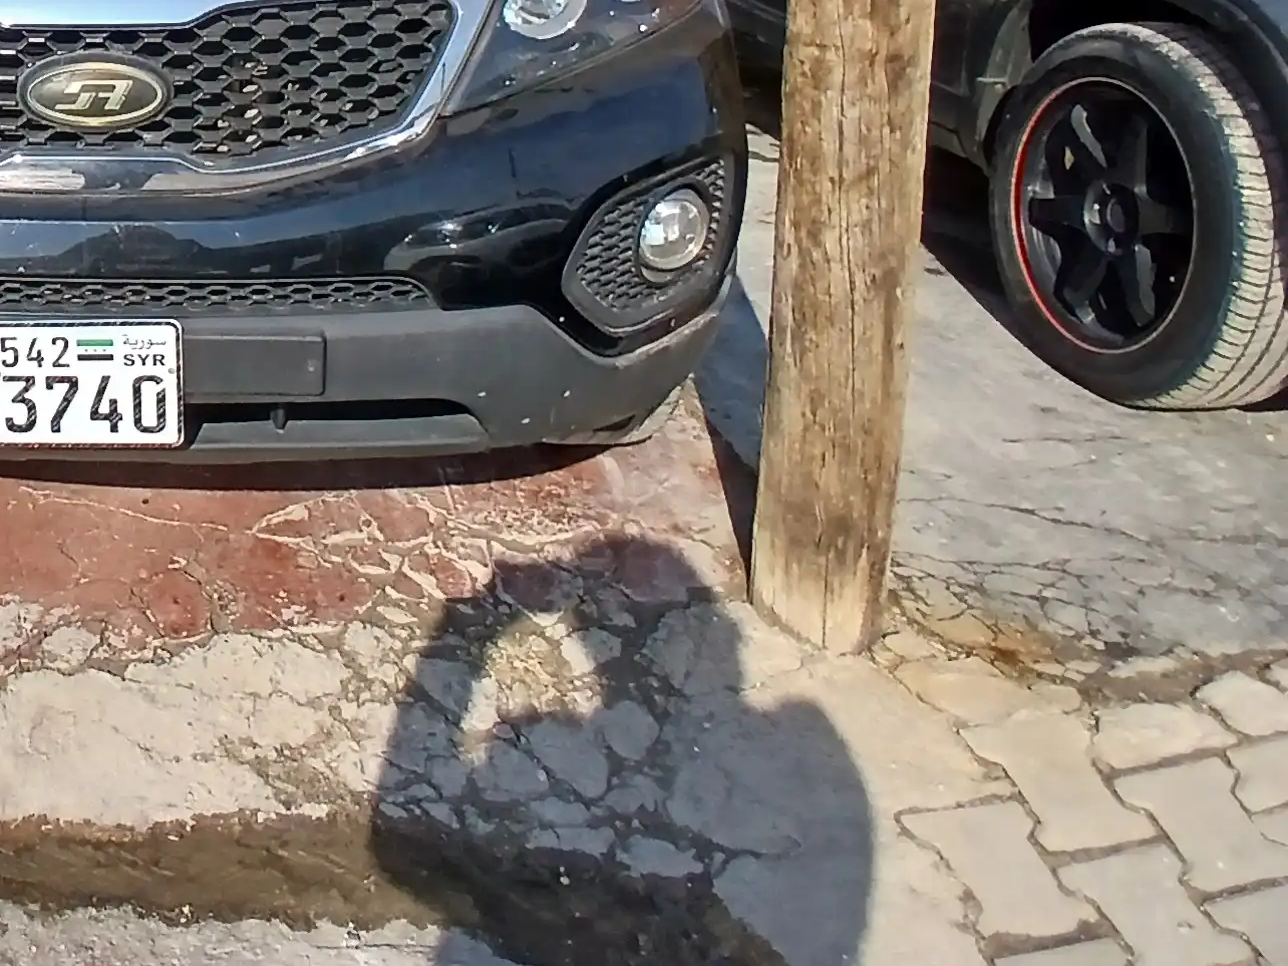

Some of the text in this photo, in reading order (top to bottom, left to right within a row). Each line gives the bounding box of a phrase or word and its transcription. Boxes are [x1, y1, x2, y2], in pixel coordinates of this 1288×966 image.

[0, 336, 70, 368] 542
[122, 333, 167, 350] سورية
[123, 353, 166, 366] SYR
[2, 374, 167, 434] 3740
